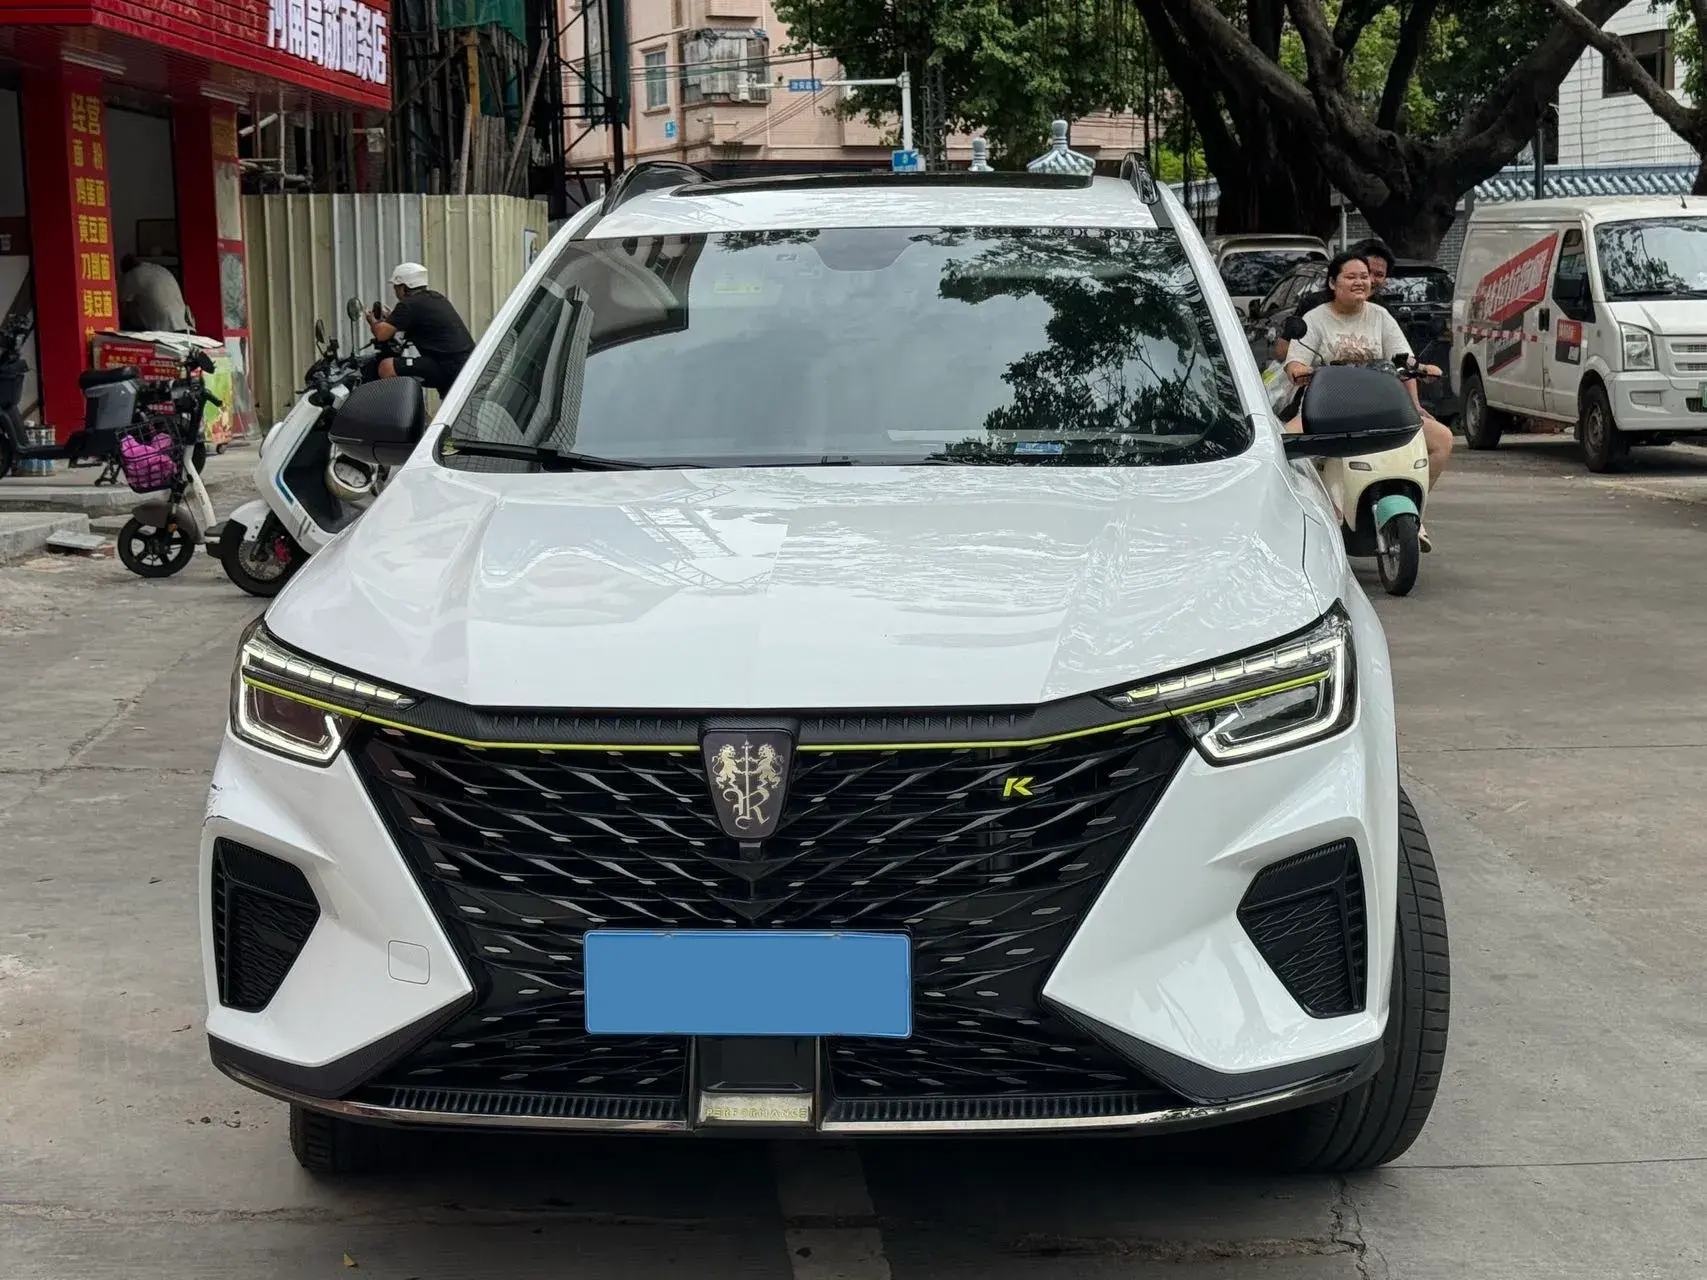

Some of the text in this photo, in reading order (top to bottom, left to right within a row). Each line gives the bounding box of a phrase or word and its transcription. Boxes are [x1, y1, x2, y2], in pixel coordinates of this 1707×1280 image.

[78, 214, 107, 243] 黄豆面
[81, 252, 110, 280] 刀削面
[84, 290, 112, 317] 绿豆面
[1003, 776, 1034, 796] K
[705, 1107, 807, 1118] PERFORMANCE
